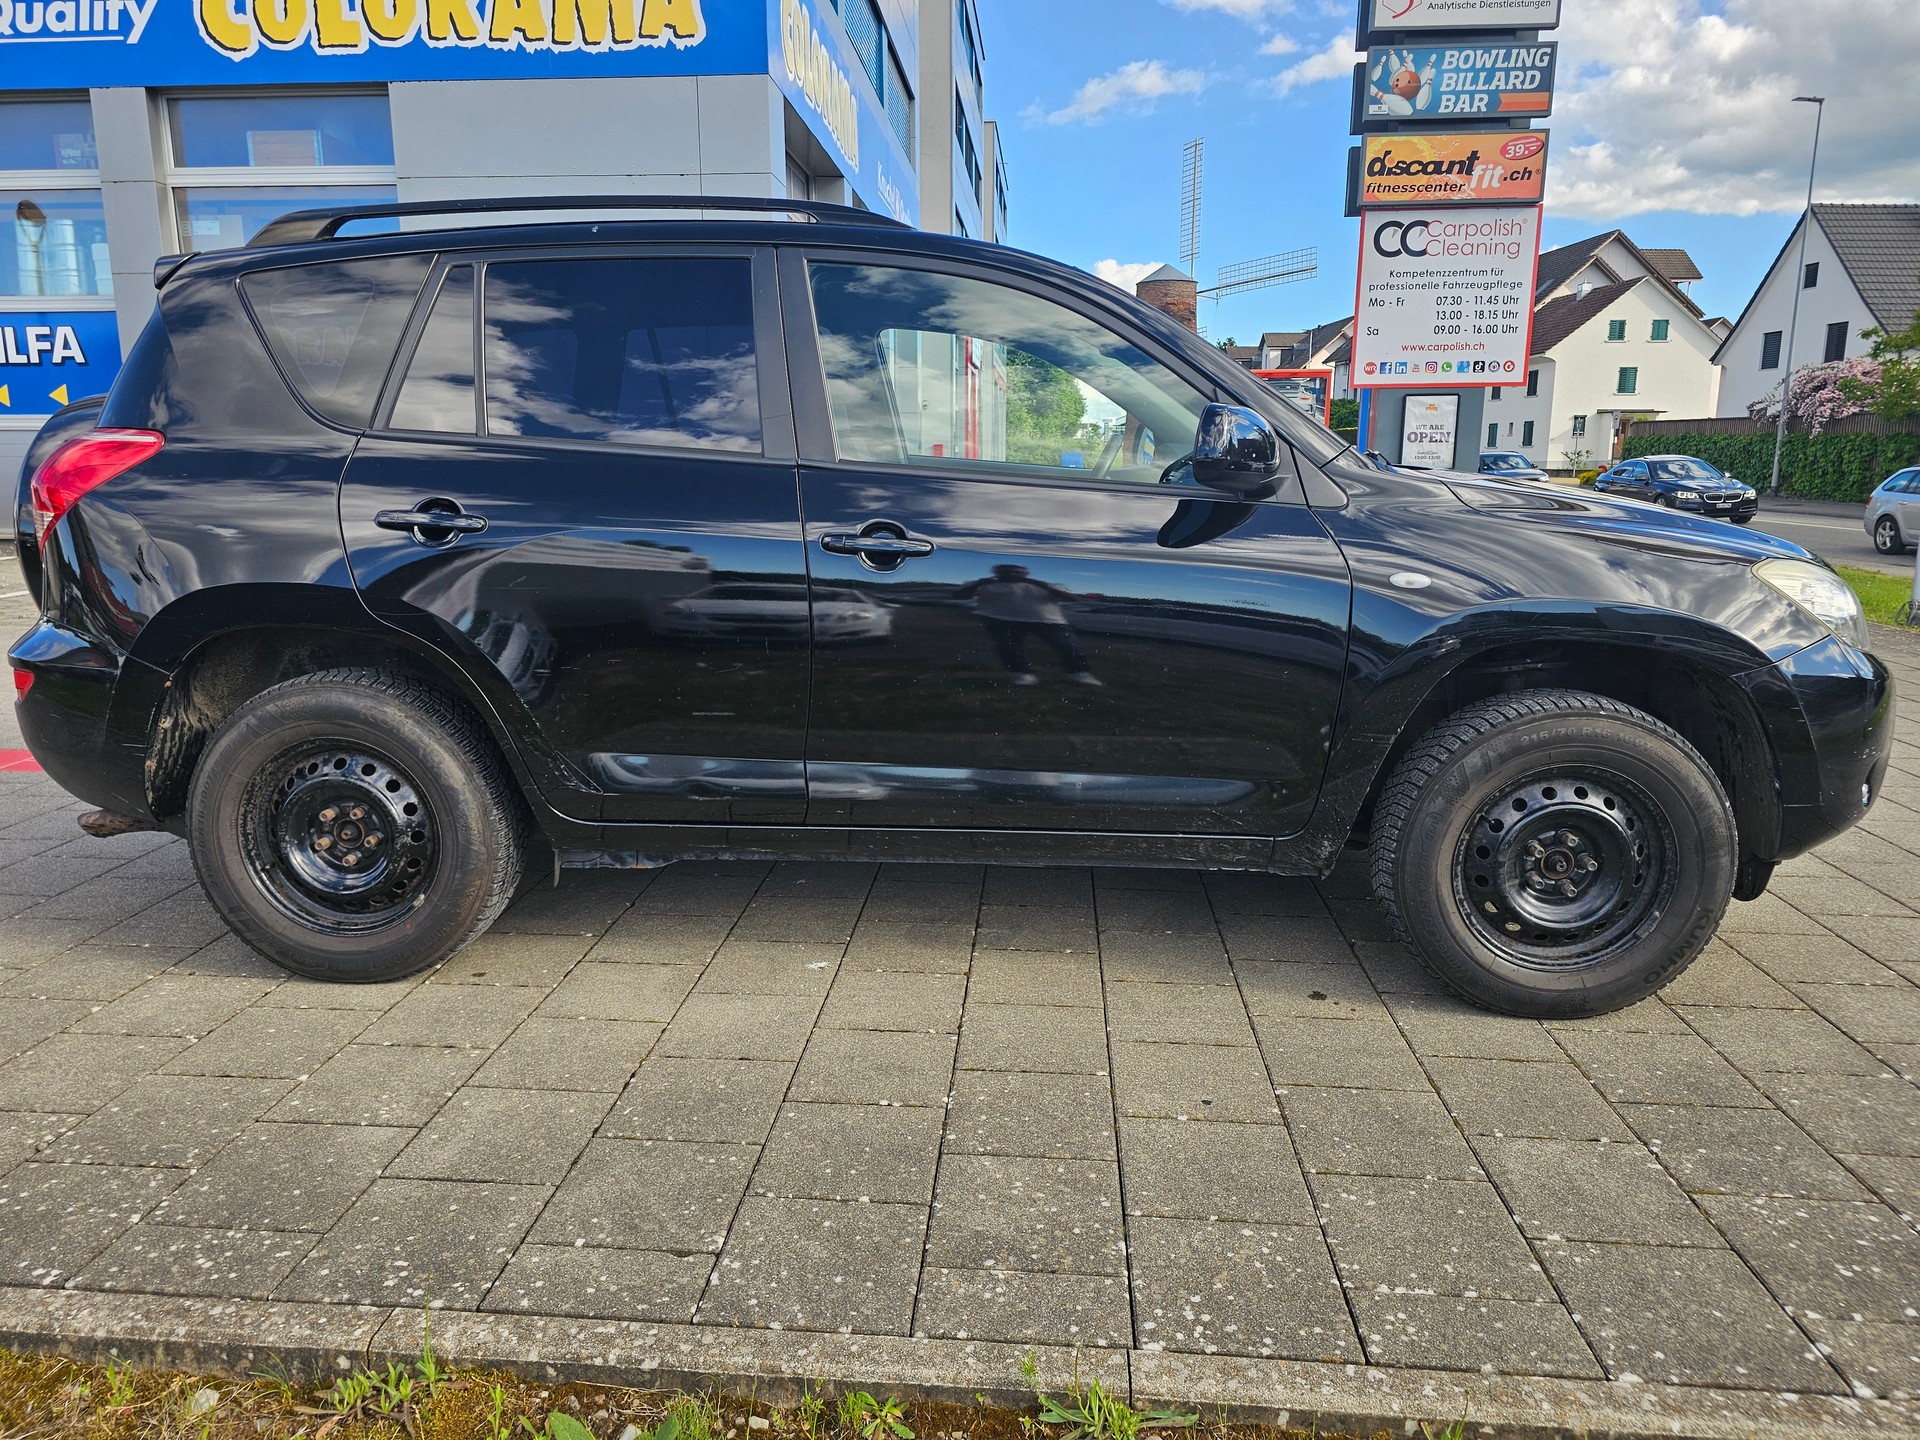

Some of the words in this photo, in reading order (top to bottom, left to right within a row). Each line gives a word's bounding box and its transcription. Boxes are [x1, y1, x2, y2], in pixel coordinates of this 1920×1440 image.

[1427, 0, 1476, 11] Analytische
[1479, 0, 1551, 9] Dienstleistungen
[1441, 47, 1551, 70] BOWLING
[781, 0, 858, 173] COLORAMA
[1440, 70, 1541, 91] BILLARD
[1438, 93, 1489, 113] BAR
[1366, 182, 1466, 193] fitnesscenter
[1425, 238, 1521, 259] Cleaning
[1389, 268, 1488, 279] Kompetenzzentrum
[1490, 267, 1504, 276] für
[1369, 281, 1440, 292] professionelle
[1442, 280, 1523, 290] Fahrzeugpflege
[1368, 297, 1385, 307] Mo
[1396, 297, 1405, 307] Fr
[1435, 296, 1463, 306] 07.30
[1474, 295, 1499, 305] 11.45
[1502, 295, 1520, 305] Uhr
[1436, 310, 1462, 320] 13.00
[1474, 309, 1499, 320] 18.15
[1501, 309, 1519, 319] Uhr
[1366, 327, 1379, 336] Sa
[1433, 325, 1461, 335] 09.00
[1472, 324, 1499, 334] 16.00
[1501, 324, 1519, 334] Uhr
[1401, 342, 1485, 353] www.carpolish.ch
[1407, 431, 1451, 443] OPEN
[1520, 727, 1576, 745] 215/70
[1581, 727, 1611, 739] R16
[1643, 907, 1715, 984] KUMHO
